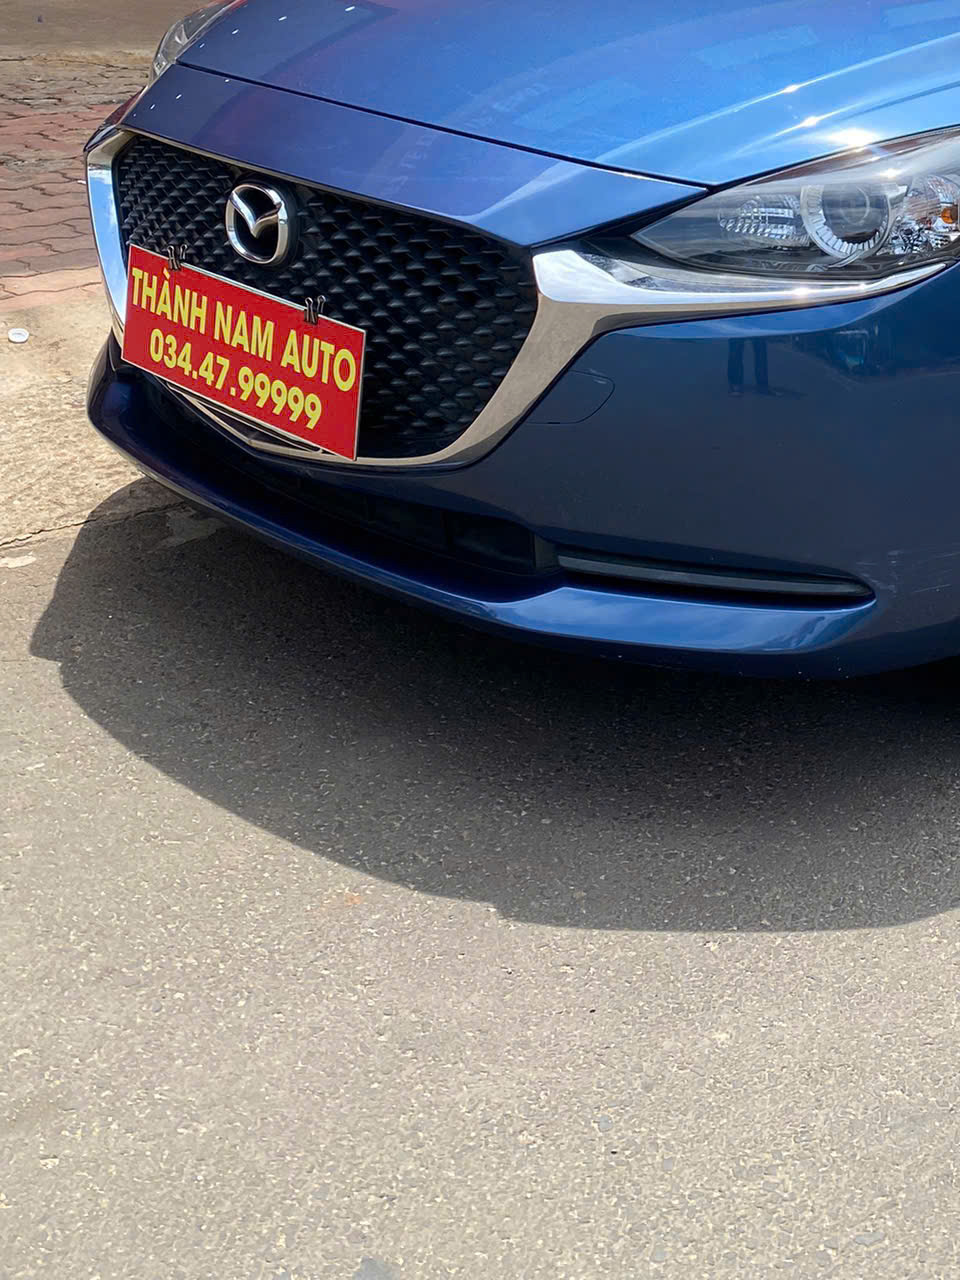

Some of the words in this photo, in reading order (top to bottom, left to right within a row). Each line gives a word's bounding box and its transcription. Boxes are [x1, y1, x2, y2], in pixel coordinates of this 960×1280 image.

[131, 266, 207, 337] THÀNH
[214, 300, 275, 362] NAM
[281, 329, 356, 393] AUTO
[149, 327, 322, 431] 034.47.99999
